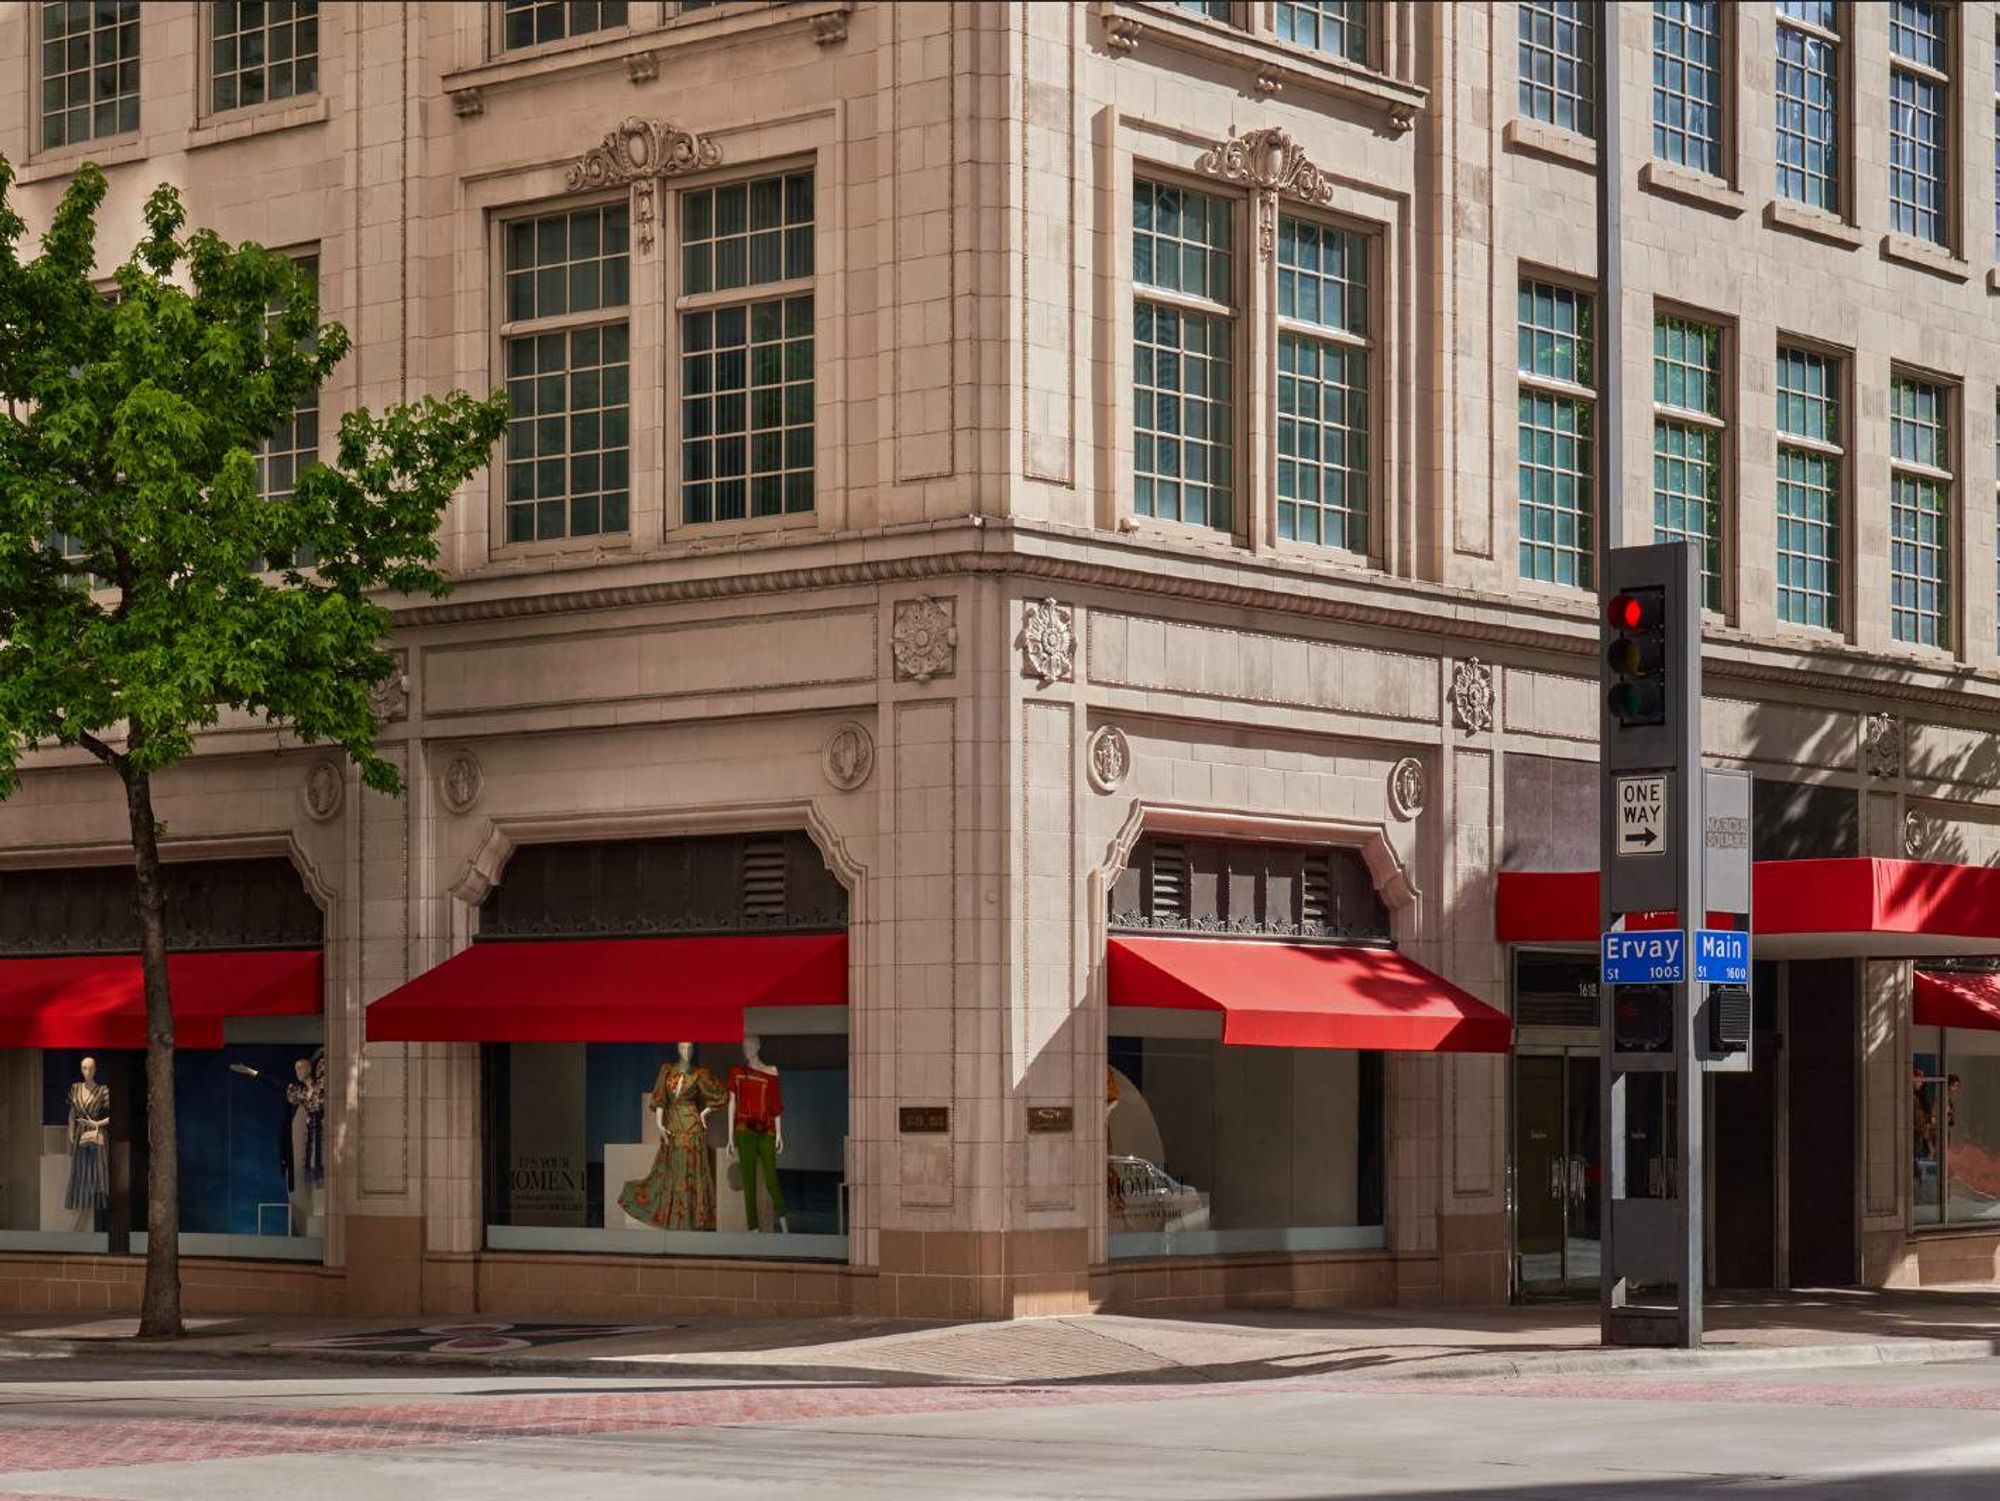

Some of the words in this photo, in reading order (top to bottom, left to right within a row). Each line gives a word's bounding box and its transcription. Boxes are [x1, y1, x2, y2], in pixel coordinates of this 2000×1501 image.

[1624, 784, 1660, 802] ONE
[1623, 805, 1661, 823] WAY
[1607, 937, 1679, 963] Ervay
[1702, 935, 1742, 959] Main
[1607, 968, 1619, 980] St
[1697, 965, 1707, 978] St
[1726, 967, 1746, 979] 1600
